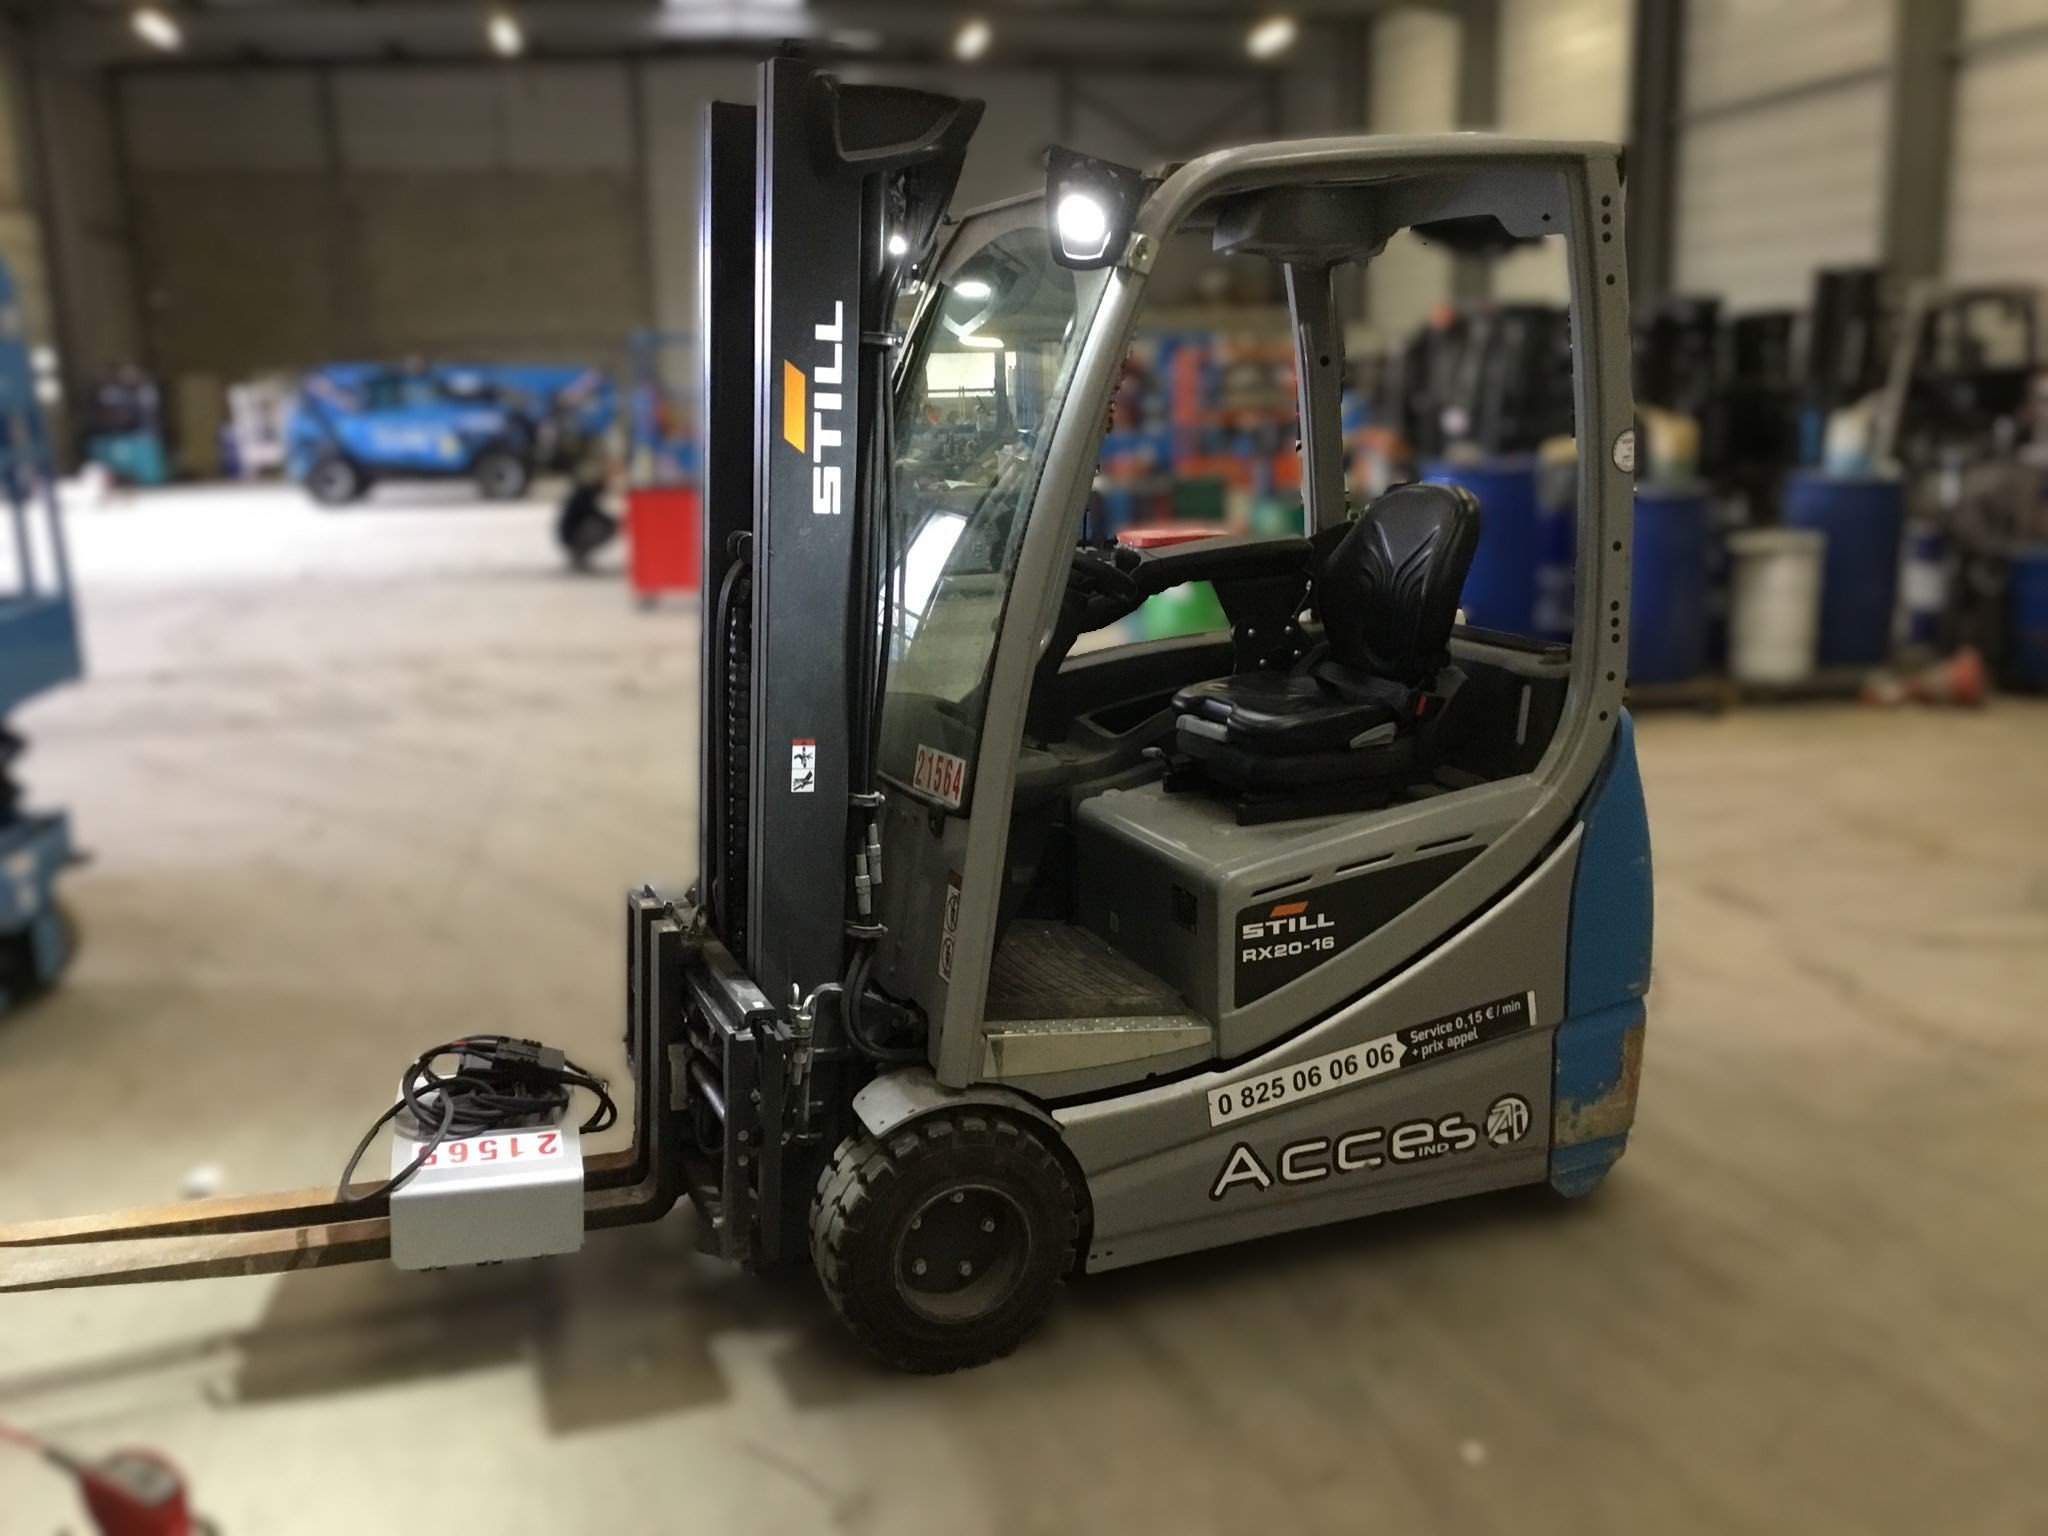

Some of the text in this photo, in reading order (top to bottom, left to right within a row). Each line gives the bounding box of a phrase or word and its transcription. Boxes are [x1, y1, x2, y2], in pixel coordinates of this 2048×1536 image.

[813, 300, 843, 515] STILL
[915, 749, 963, 801] 21564
[1242, 913, 1335, 940] STILL
[1242, 936, 1335, 963] RX20-16
[1410, 1022, 1453, 1043] Service
[1455, 1010, 1483, 1029] 0,15
[1485, 1006, 1495, 1019] €
[1502, 1000, 1521, 1015] min
[1412, 1026, 1479, 1060] + prix appel
[1218, 1043, 1394, 1116] 0 825 06 06 06
[1418, 1142, 1450, 1157] IND
